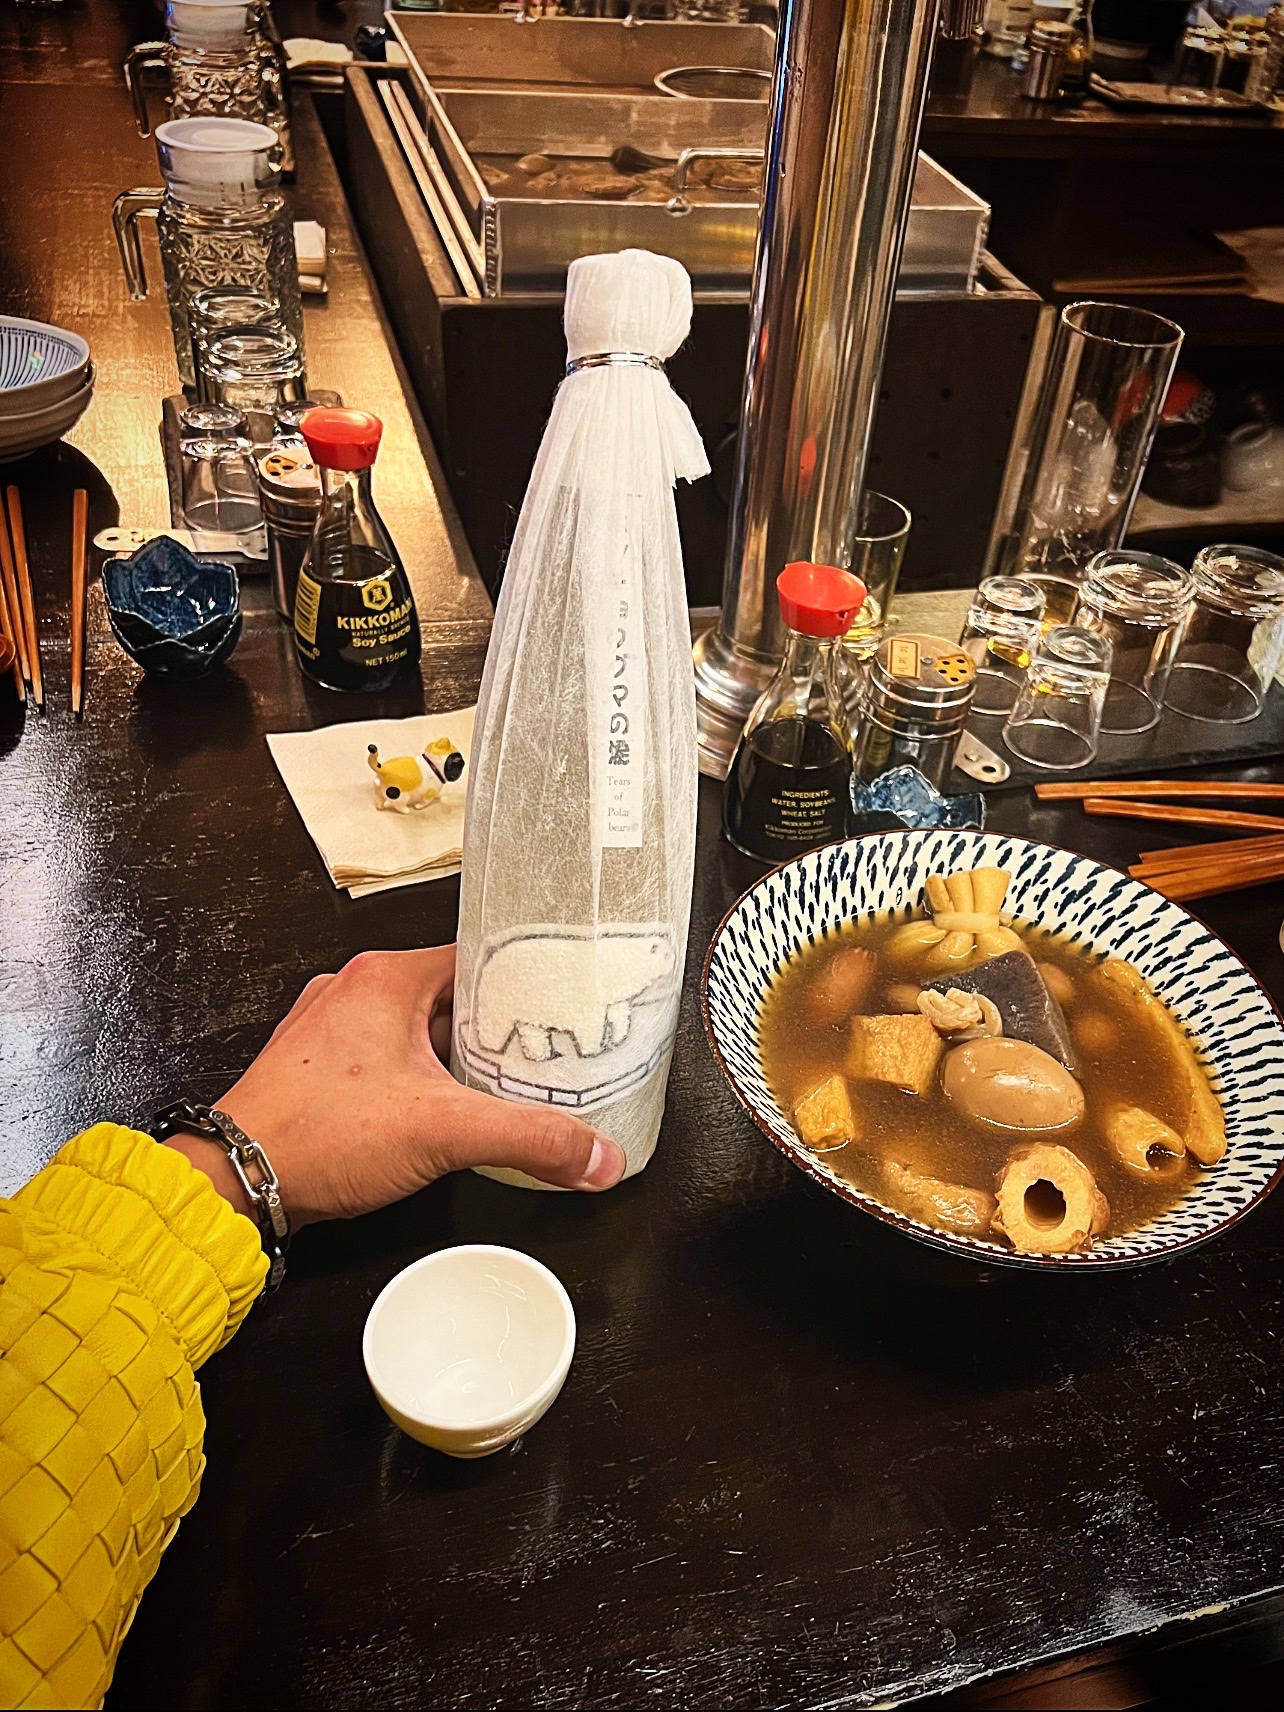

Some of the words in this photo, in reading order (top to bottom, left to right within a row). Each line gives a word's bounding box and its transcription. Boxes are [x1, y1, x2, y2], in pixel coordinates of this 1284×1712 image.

[337, 597, 412, 630] KIKKOMAN
[352, 638, 377, 648] Soy
[379, 625, 411, 645] Sauce
[365, 656, 383, 667] NET
[606, 775, 631, 786] Tears
[614, 791, 625, 801] of
[607, 807, 630, 817] Polar
